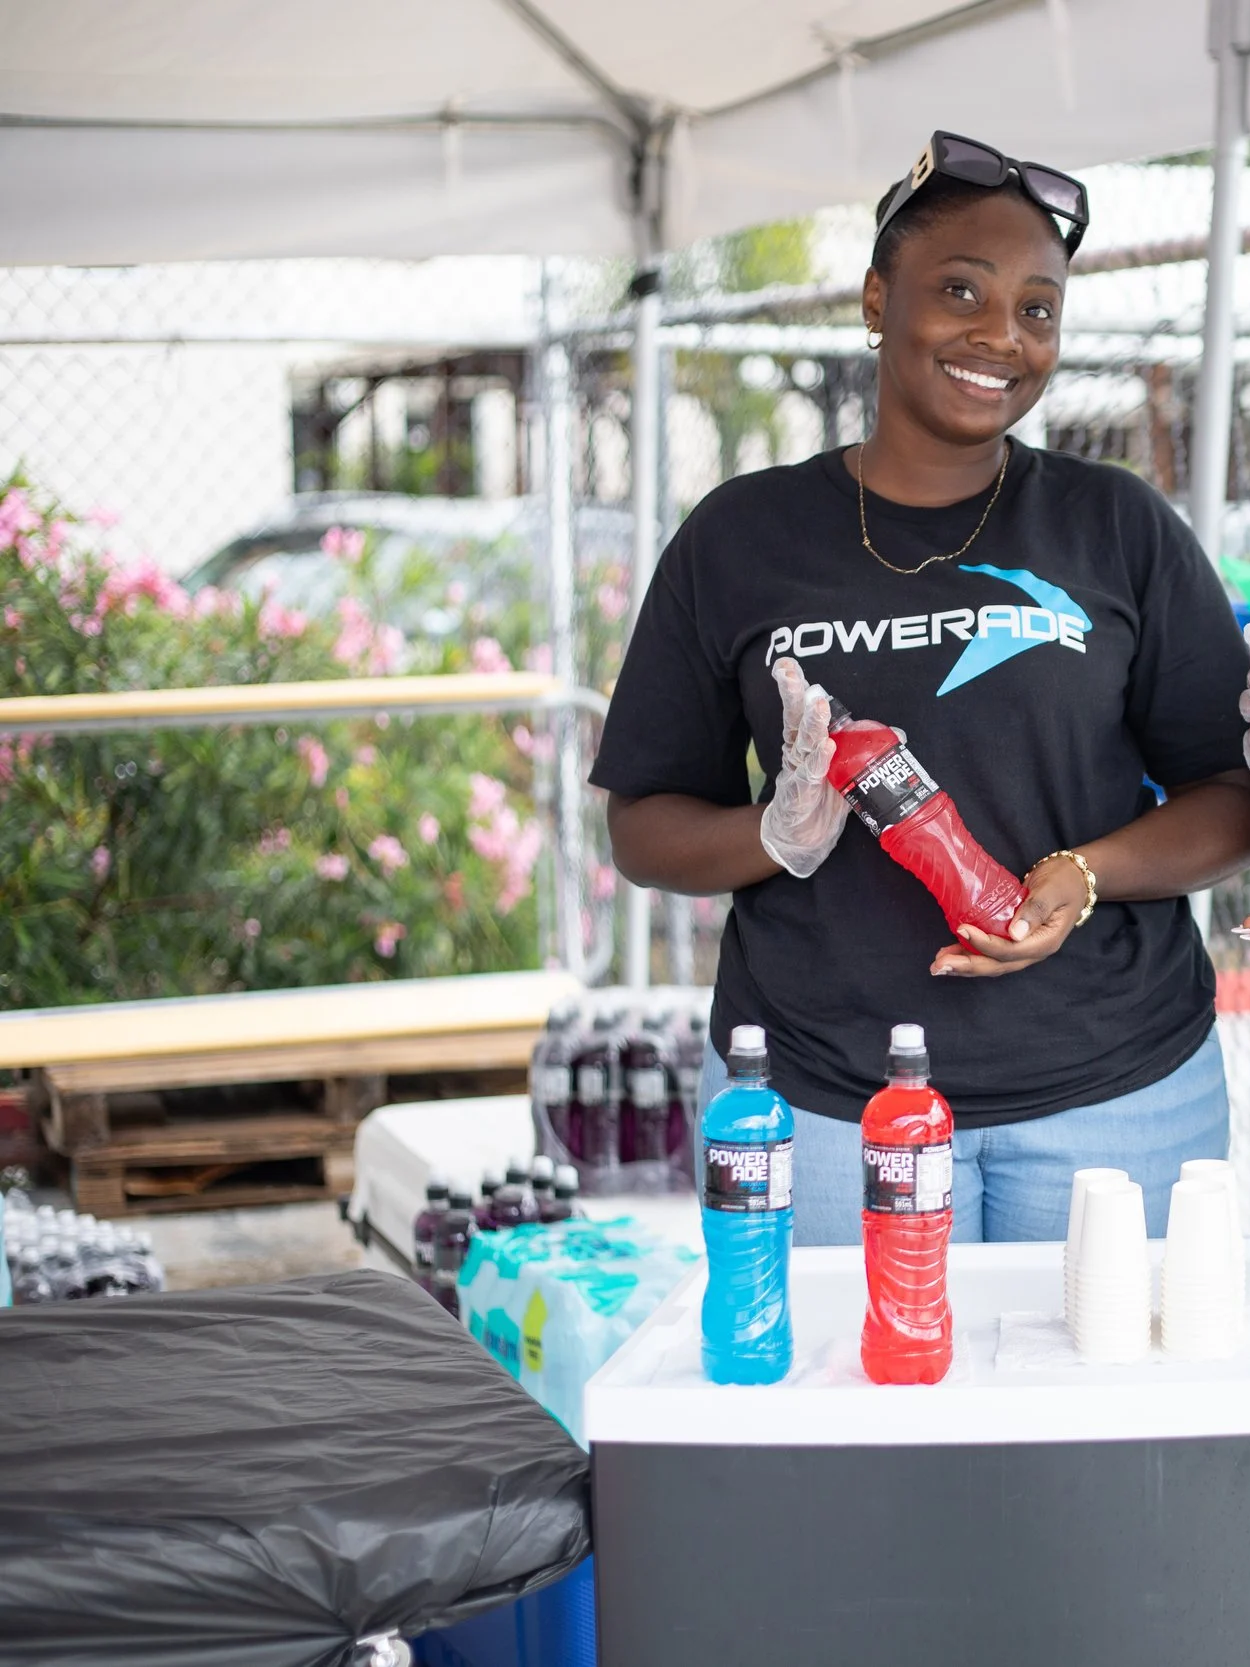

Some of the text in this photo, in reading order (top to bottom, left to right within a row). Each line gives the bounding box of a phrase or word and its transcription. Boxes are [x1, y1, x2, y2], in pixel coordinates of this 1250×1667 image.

[765, 604, 1087, 667] POWERADE
[858, 753, 906, 795] POWER
[886, 764, 914, 789] ADE
[709, 1149, 768, 1167] POWER
[864, 1148, 914, 1168] POWER
[732, 1166, 767, 1181] ADE
[879, 1167, 914, 1182] ADE
